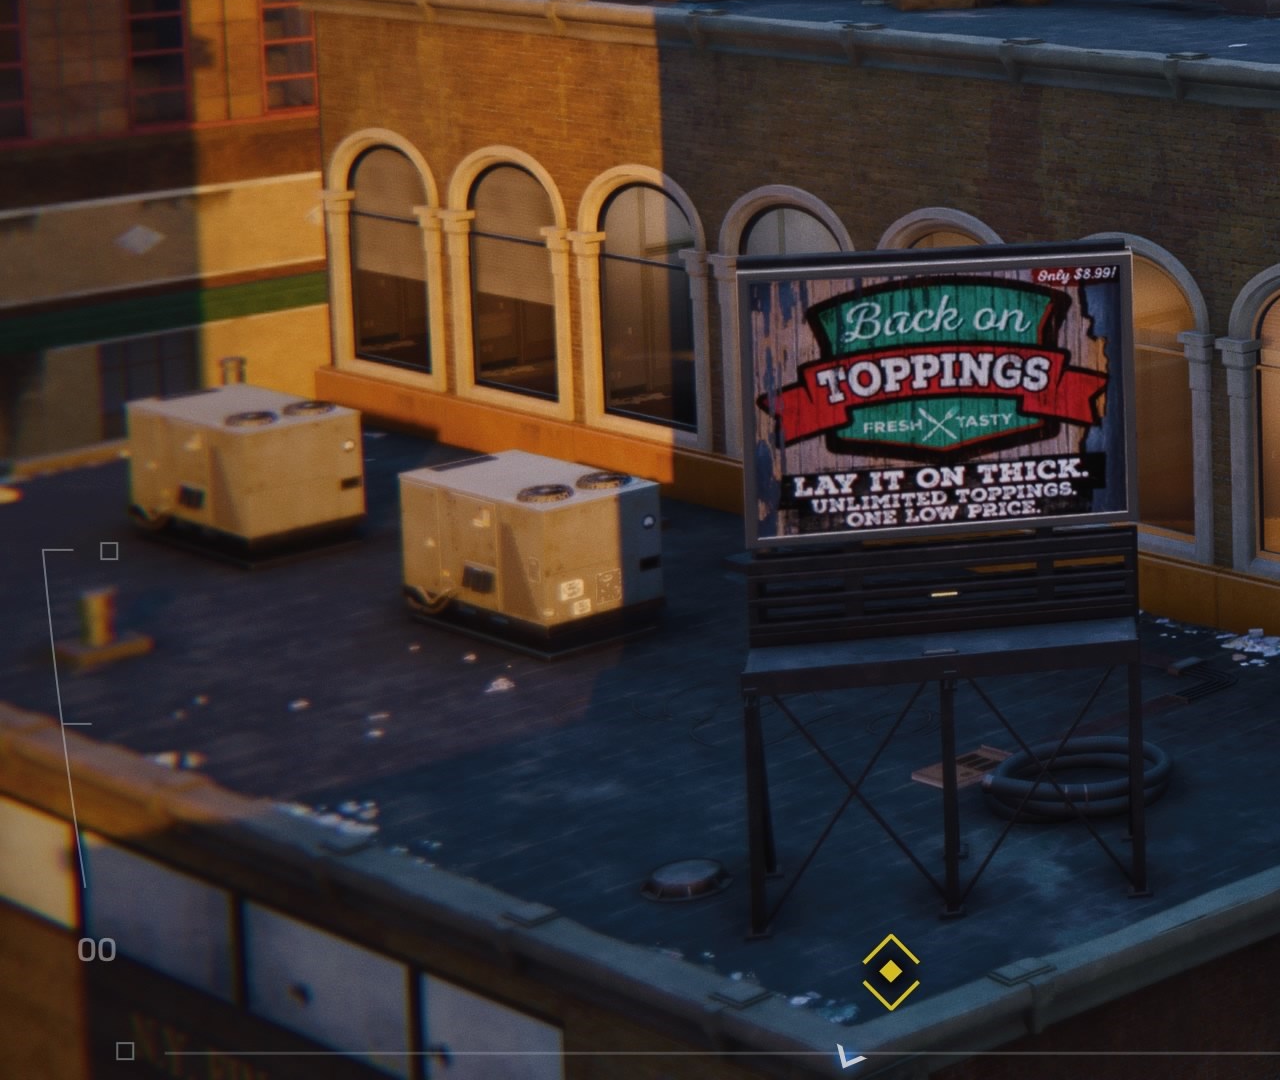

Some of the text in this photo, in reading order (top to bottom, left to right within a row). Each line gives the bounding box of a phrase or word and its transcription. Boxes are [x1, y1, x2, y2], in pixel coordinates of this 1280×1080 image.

[1037, 266, 1118, 286] Only $8.99!
[844, 295, 1033, 344] Back on
[816, 351, 1053, 404] TOPPINGS
[862, 412, 1014, 435] FRESH TASTY
[793, 458, 1089, 498] LAY IT ON THICK.
[812, 481, 1078, 515] UNLIMITED TOPPINGS.
[846, 499, 1042, 529] ONE LOW PRICE.
